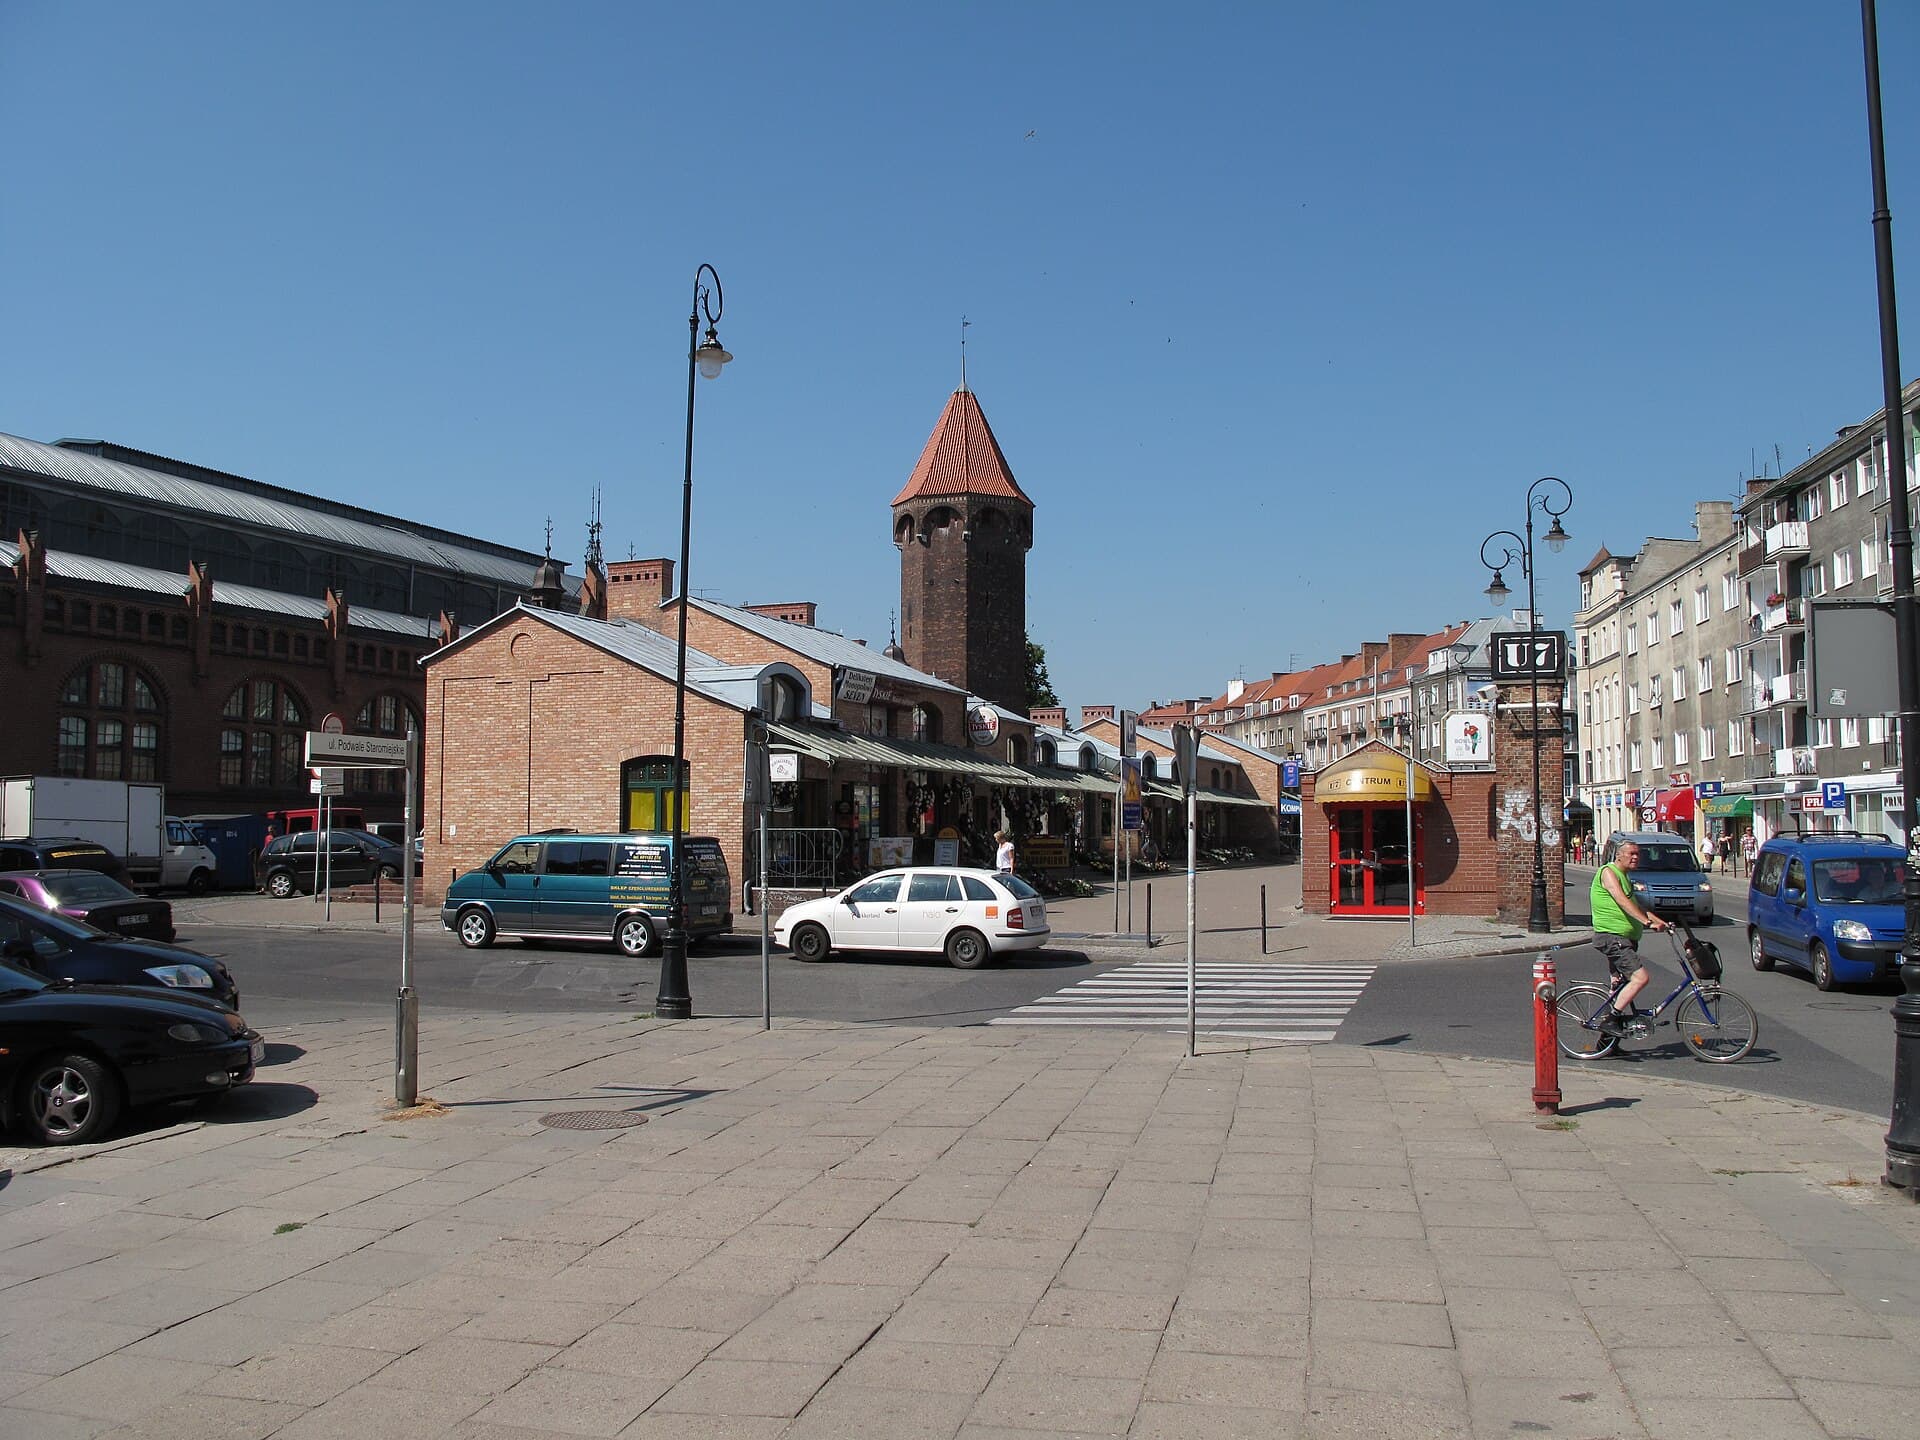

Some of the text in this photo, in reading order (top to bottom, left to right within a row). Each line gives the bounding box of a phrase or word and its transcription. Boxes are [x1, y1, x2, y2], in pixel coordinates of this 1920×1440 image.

[1504, 642, 1550, 667] U7
[970, 720, 996, 731] TYSKIE
[328, 737, 337, 750] ul.
[338, 738, 365, 752] Podwale
[1345, 777, 1391, 786] CNTRUM
[1826, 784, 1840, 801] P
